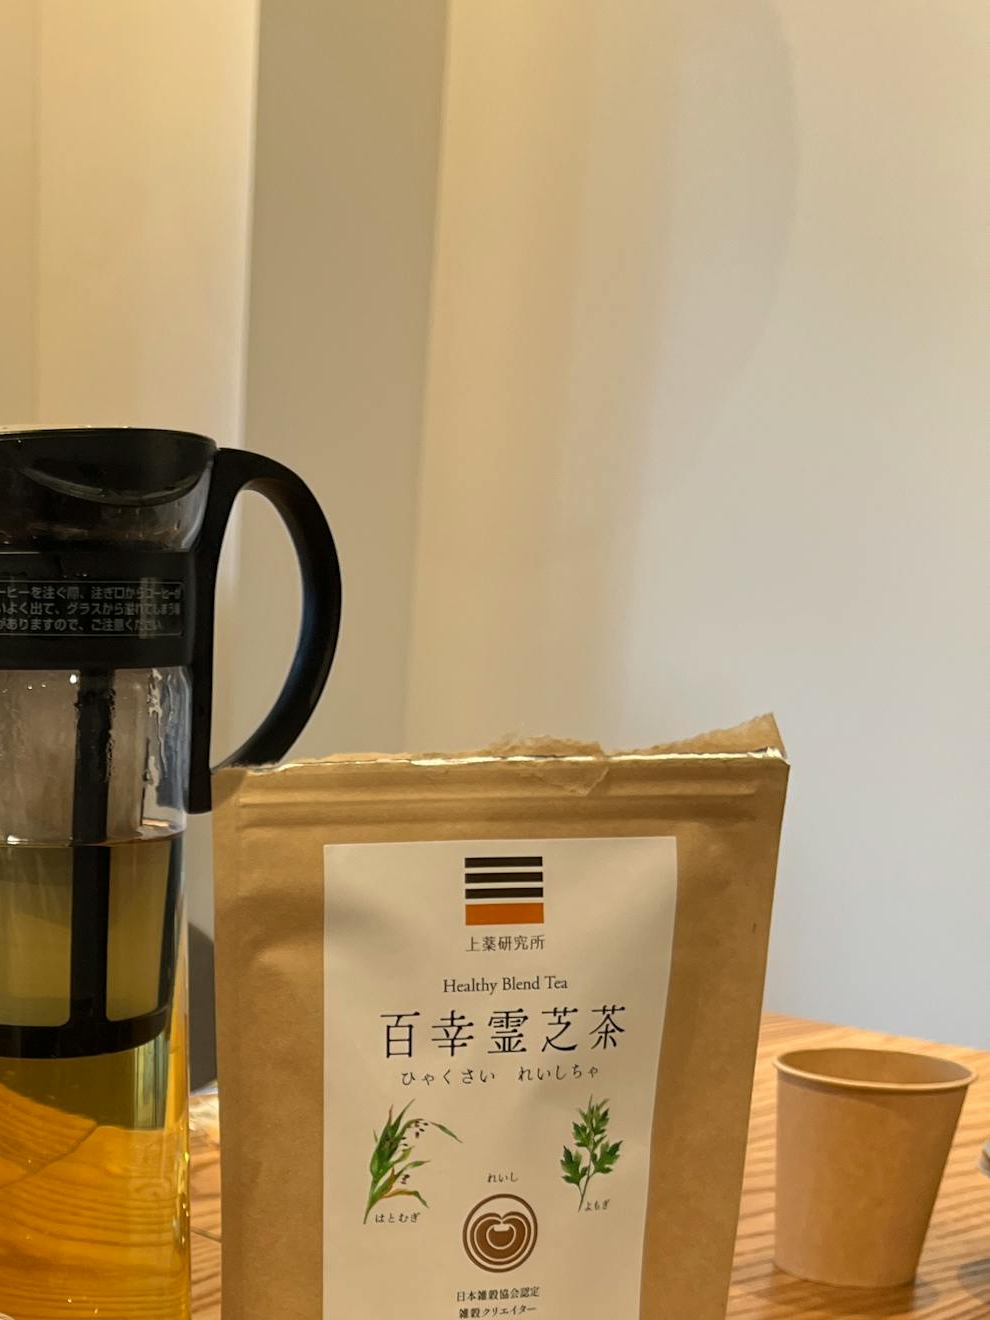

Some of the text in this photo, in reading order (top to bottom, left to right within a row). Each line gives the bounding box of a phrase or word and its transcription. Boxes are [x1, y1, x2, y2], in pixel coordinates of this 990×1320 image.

[465, 934, 546, 952] 上薬研究所
[443, 975, 569, 995] Healthy Blend Tea
[380, 1004, 626, 1059] 百幸霊芝茶
[401, 1063, 600, 1086] ひゃくさい れいしちゃ
[487, 1171, 519, 1184] れいし
[584, 1199, 610, 1212] よもぎ
[375, 1211, 421, 1225] はとむぎ
[456, 1286, 541, 1302] 日本雑穀協会認定
[459, 1304, 537, 1320] 雑穀クリエイター
